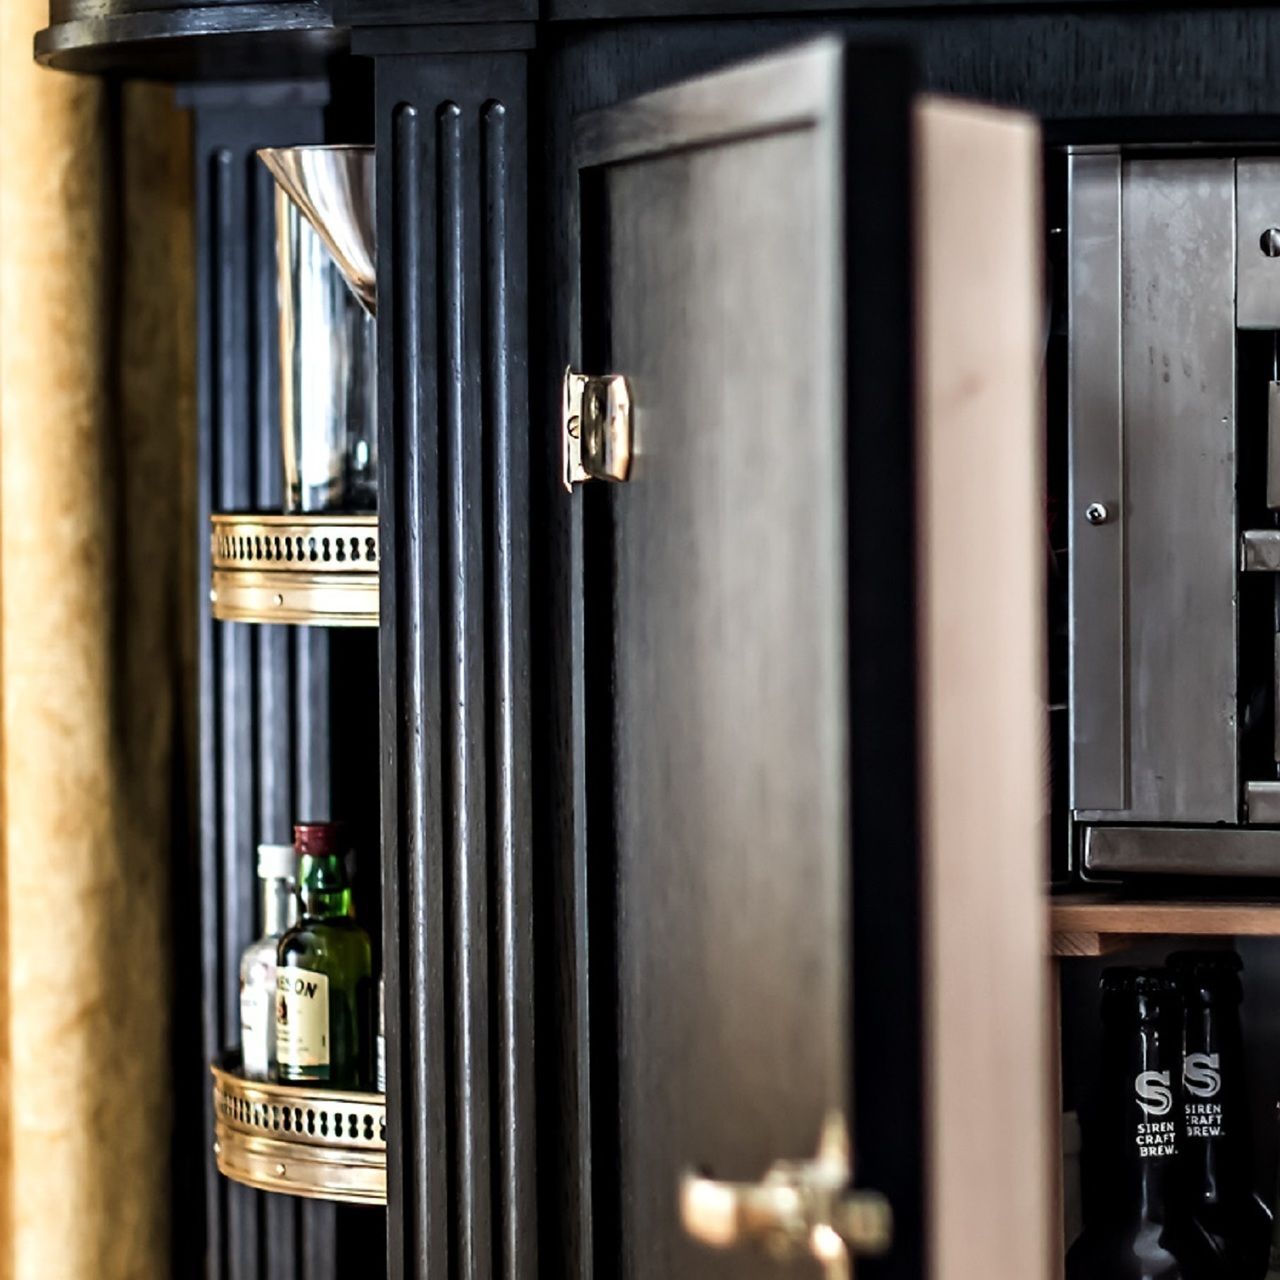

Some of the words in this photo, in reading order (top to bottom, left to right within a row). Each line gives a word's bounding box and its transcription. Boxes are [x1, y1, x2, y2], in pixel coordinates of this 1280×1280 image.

[1134, 1070, 1173, 1115] S
[1184, 1103, 1222, 1114] SIREN
[1137, 1121, 1175, 1134] SIREN
[1135, 1132, 1176, 1145] CRAFT
